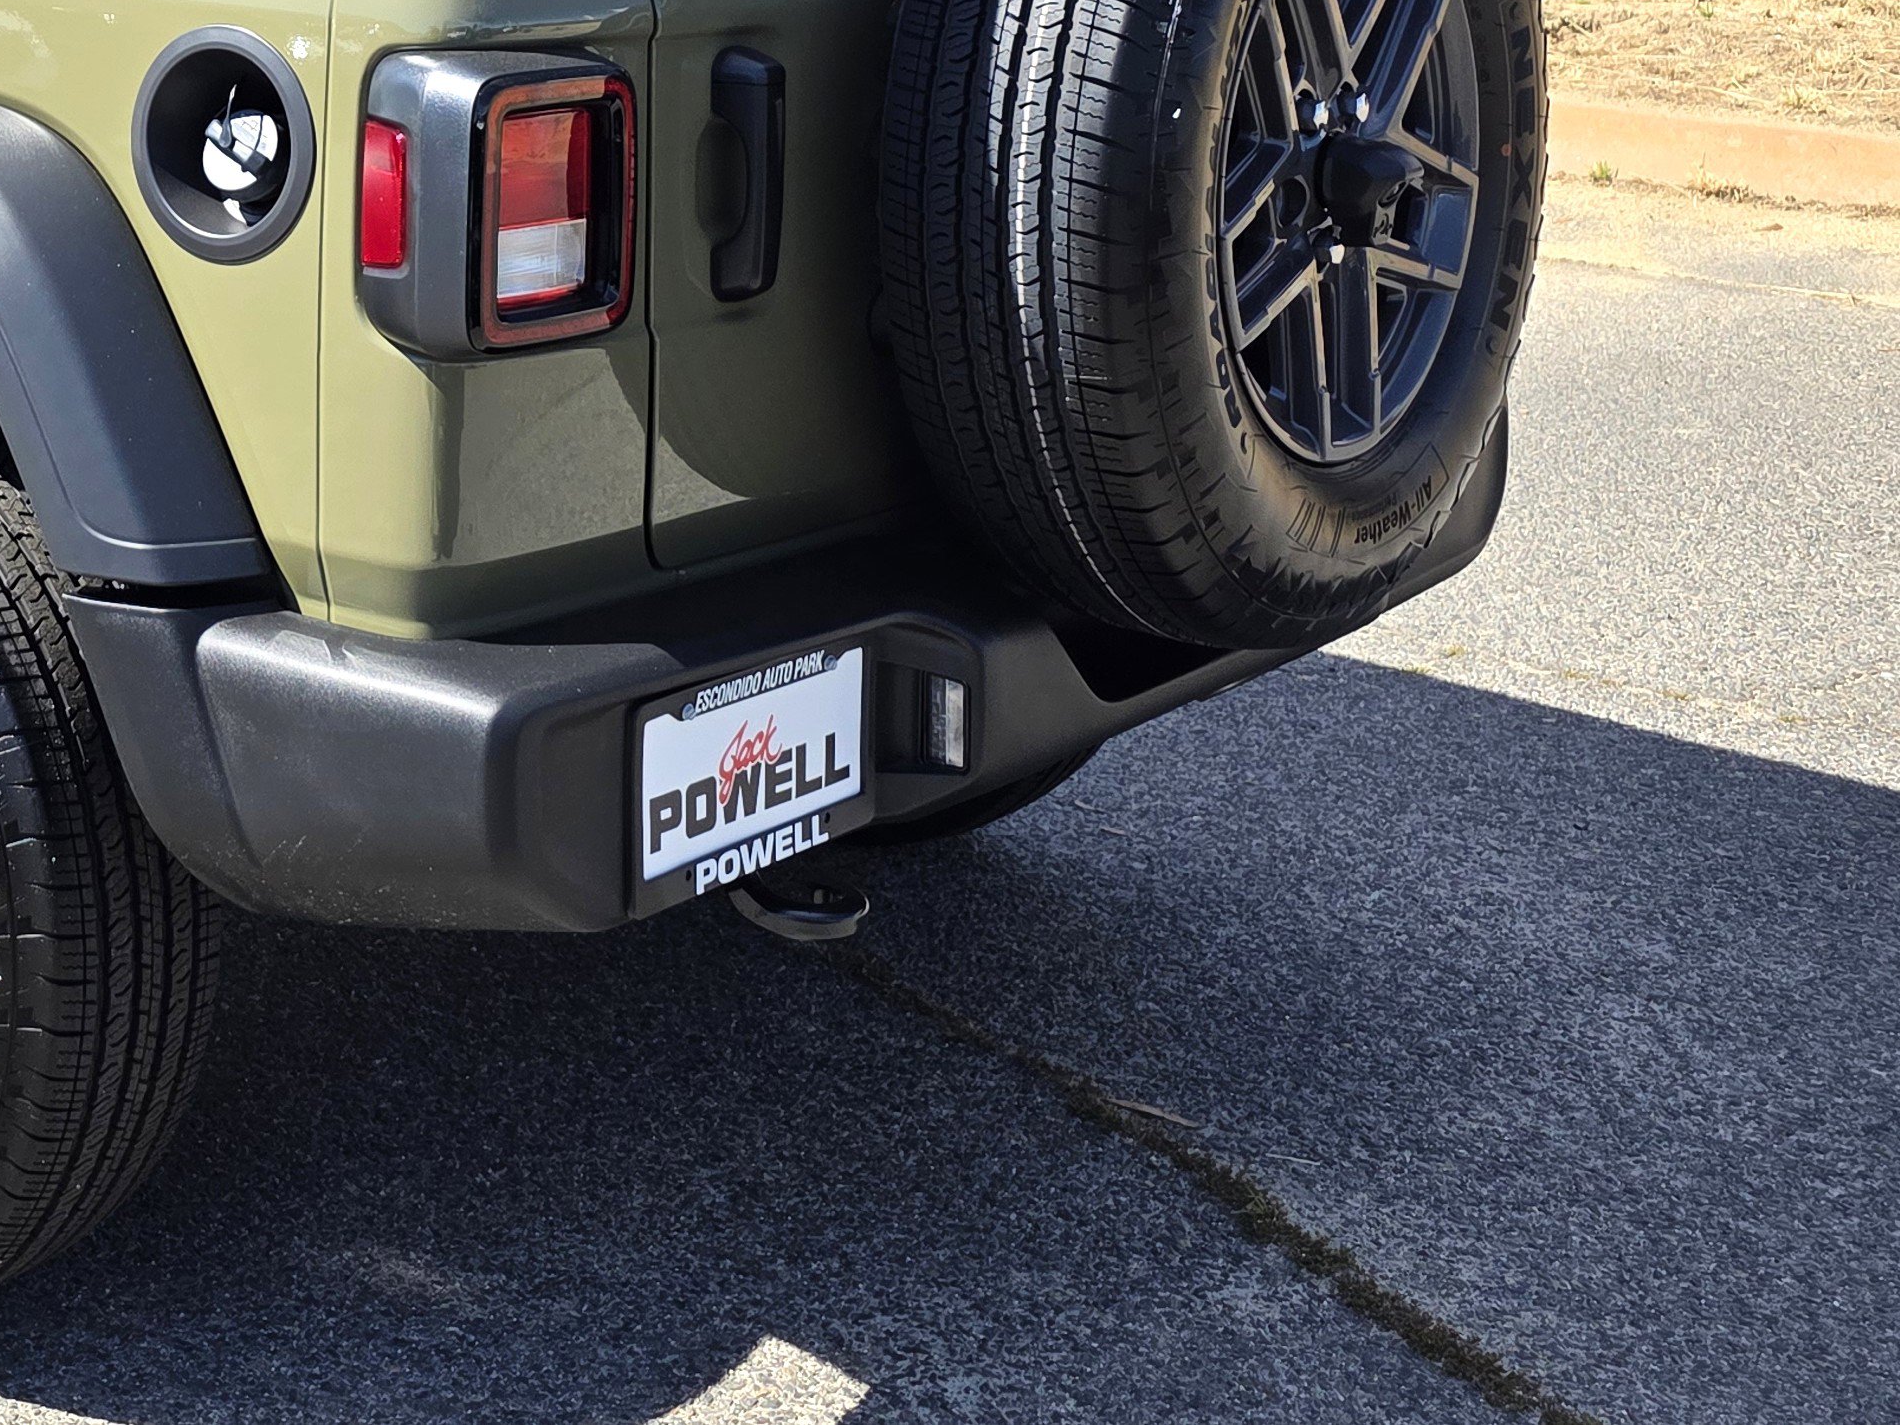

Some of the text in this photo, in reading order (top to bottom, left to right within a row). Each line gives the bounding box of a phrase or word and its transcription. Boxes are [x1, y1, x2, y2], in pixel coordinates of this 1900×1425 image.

[1490, 26, 1535, 331] NEXEN
[1354, 475, 1432, 544] All-Weather
[694, 649, 826, 713] ESCONDIDO AUTO PARK
[649, 732, 850, 855] POWELL
[719, 714, 782, 805] Jack
[696, 814, 830, 896] POWELL
